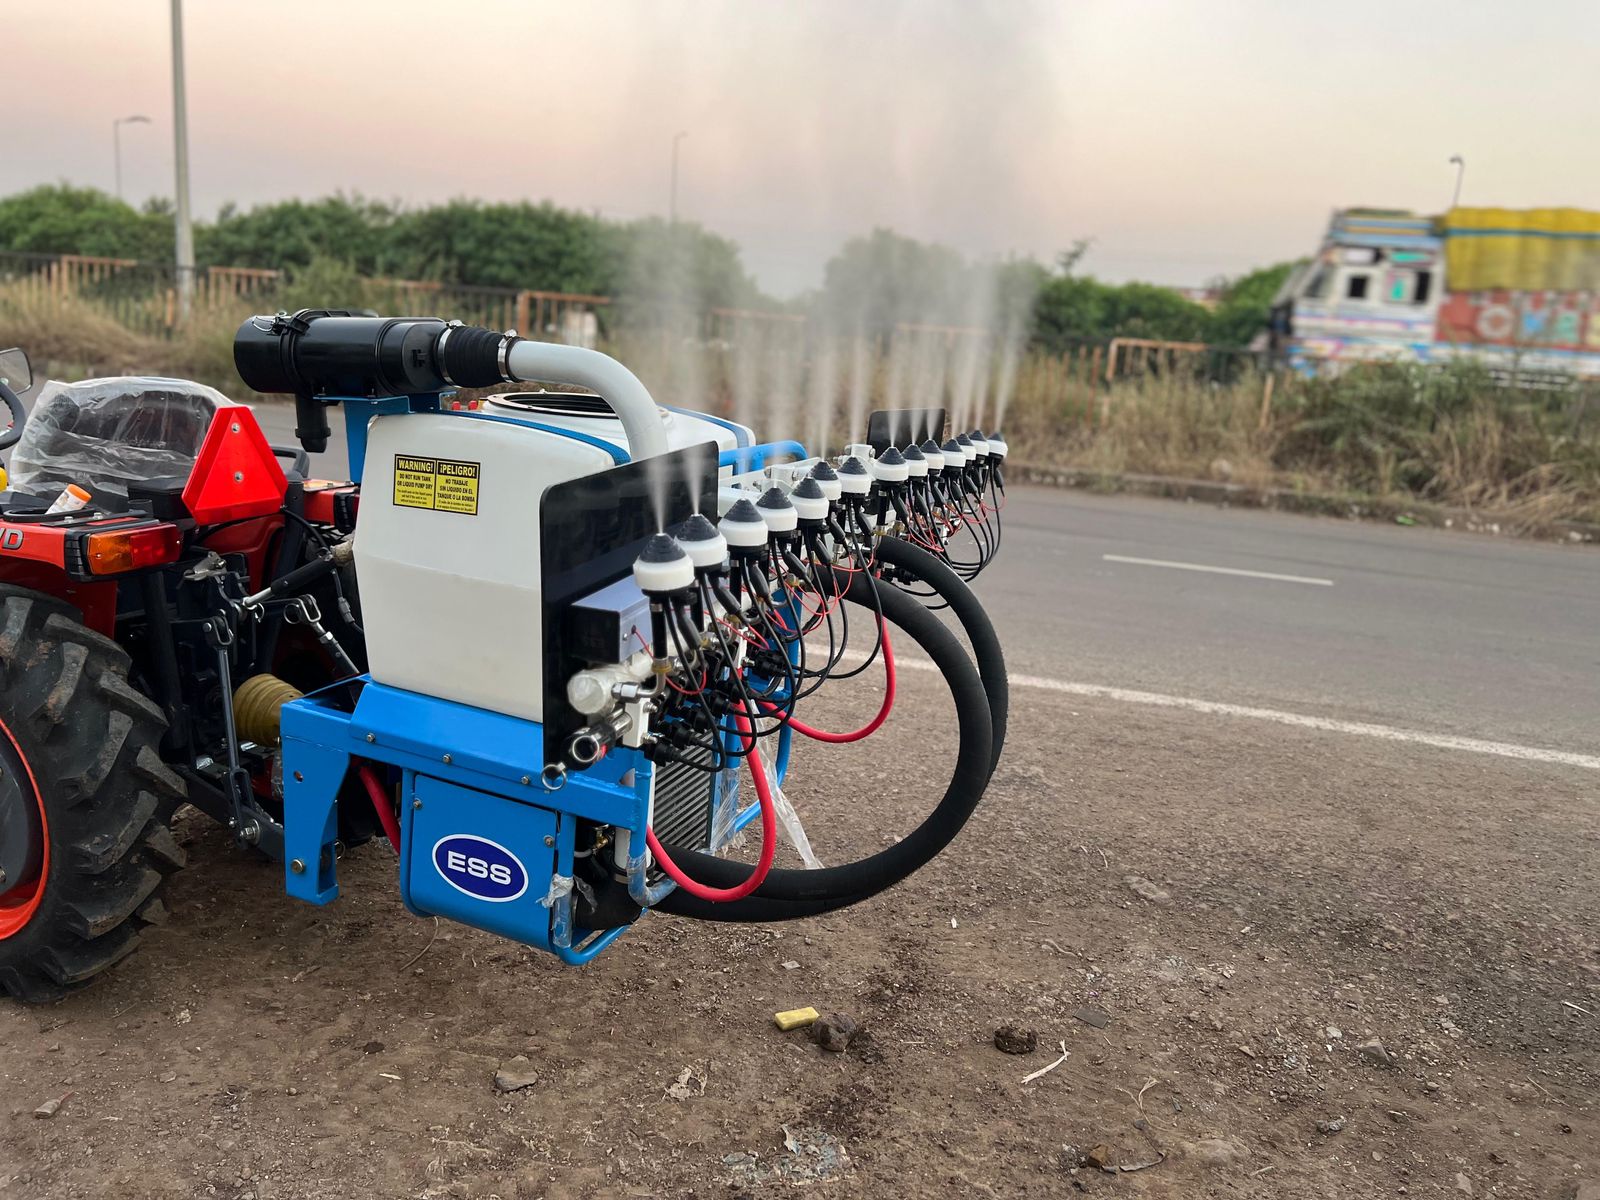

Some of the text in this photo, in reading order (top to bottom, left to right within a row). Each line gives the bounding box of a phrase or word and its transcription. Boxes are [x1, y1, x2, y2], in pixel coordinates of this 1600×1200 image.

[399, 459, 433, 472] WARNING!
[440, 464, 475, 476] ¡PELIGRO!
[448, 850, 511, 885] ESS
